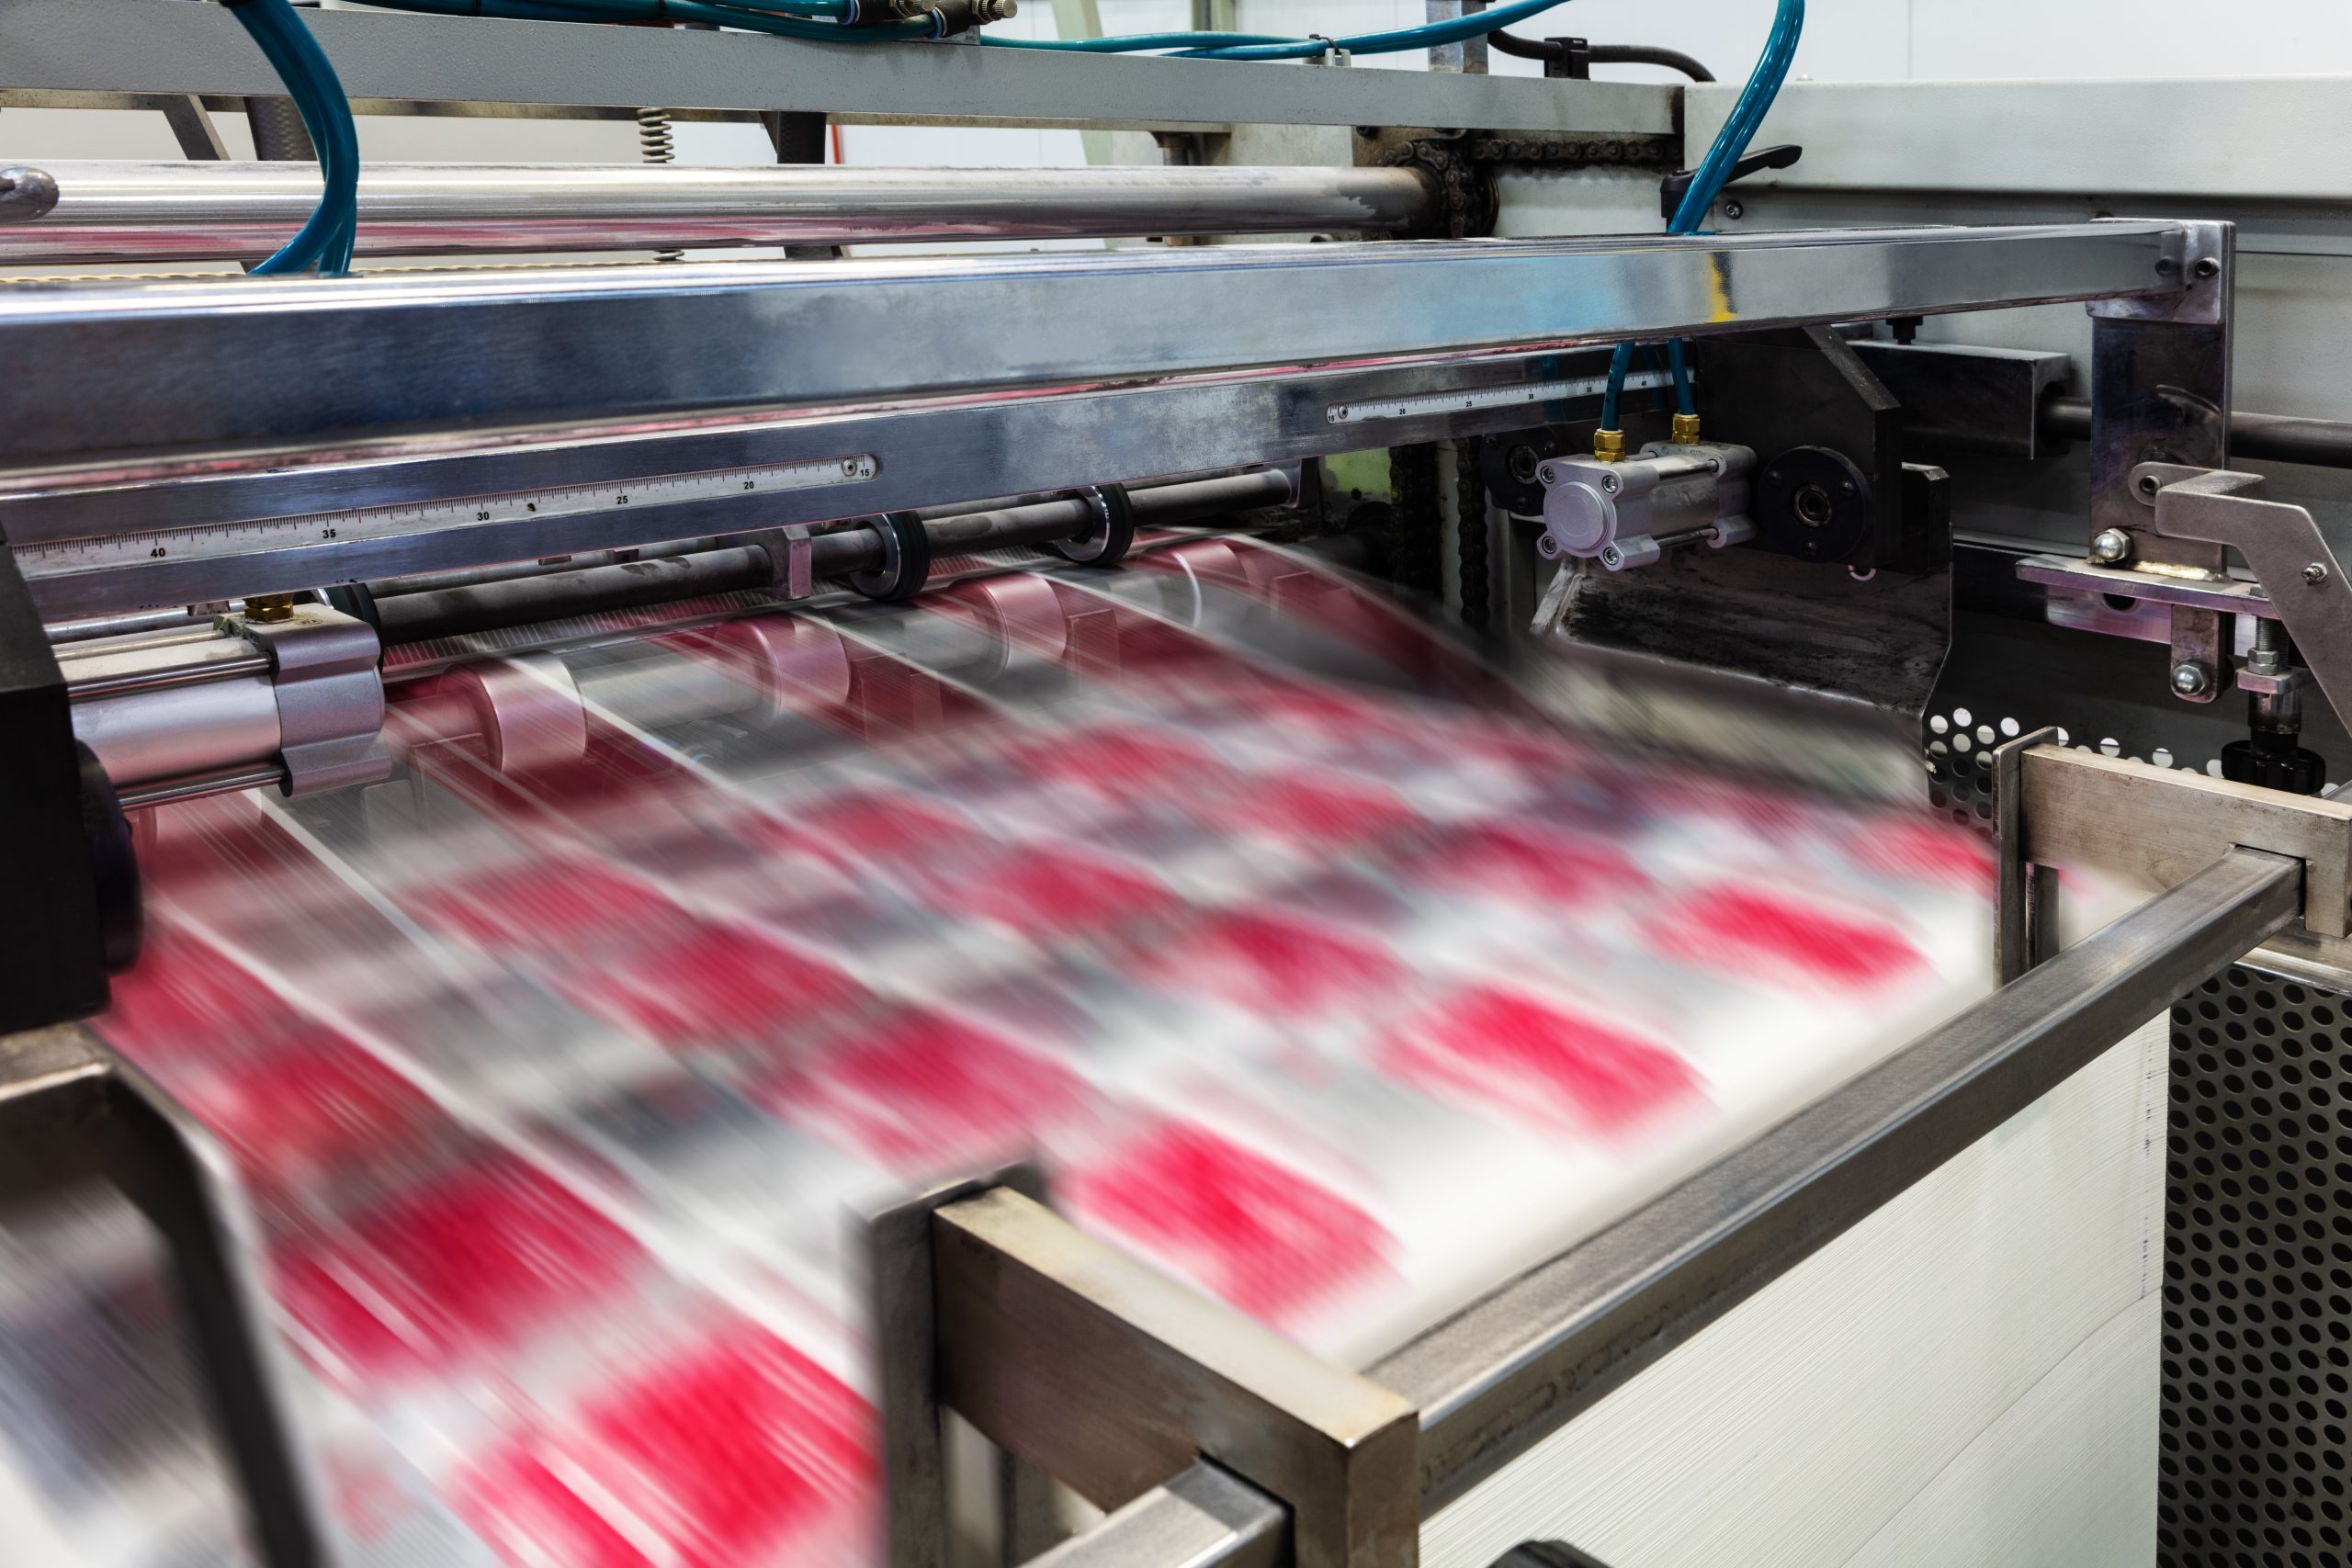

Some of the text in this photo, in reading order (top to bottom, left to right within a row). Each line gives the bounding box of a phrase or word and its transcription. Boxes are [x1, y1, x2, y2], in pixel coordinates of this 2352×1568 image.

[151, 468, 870, 558] 40 35 30 25 20 15
